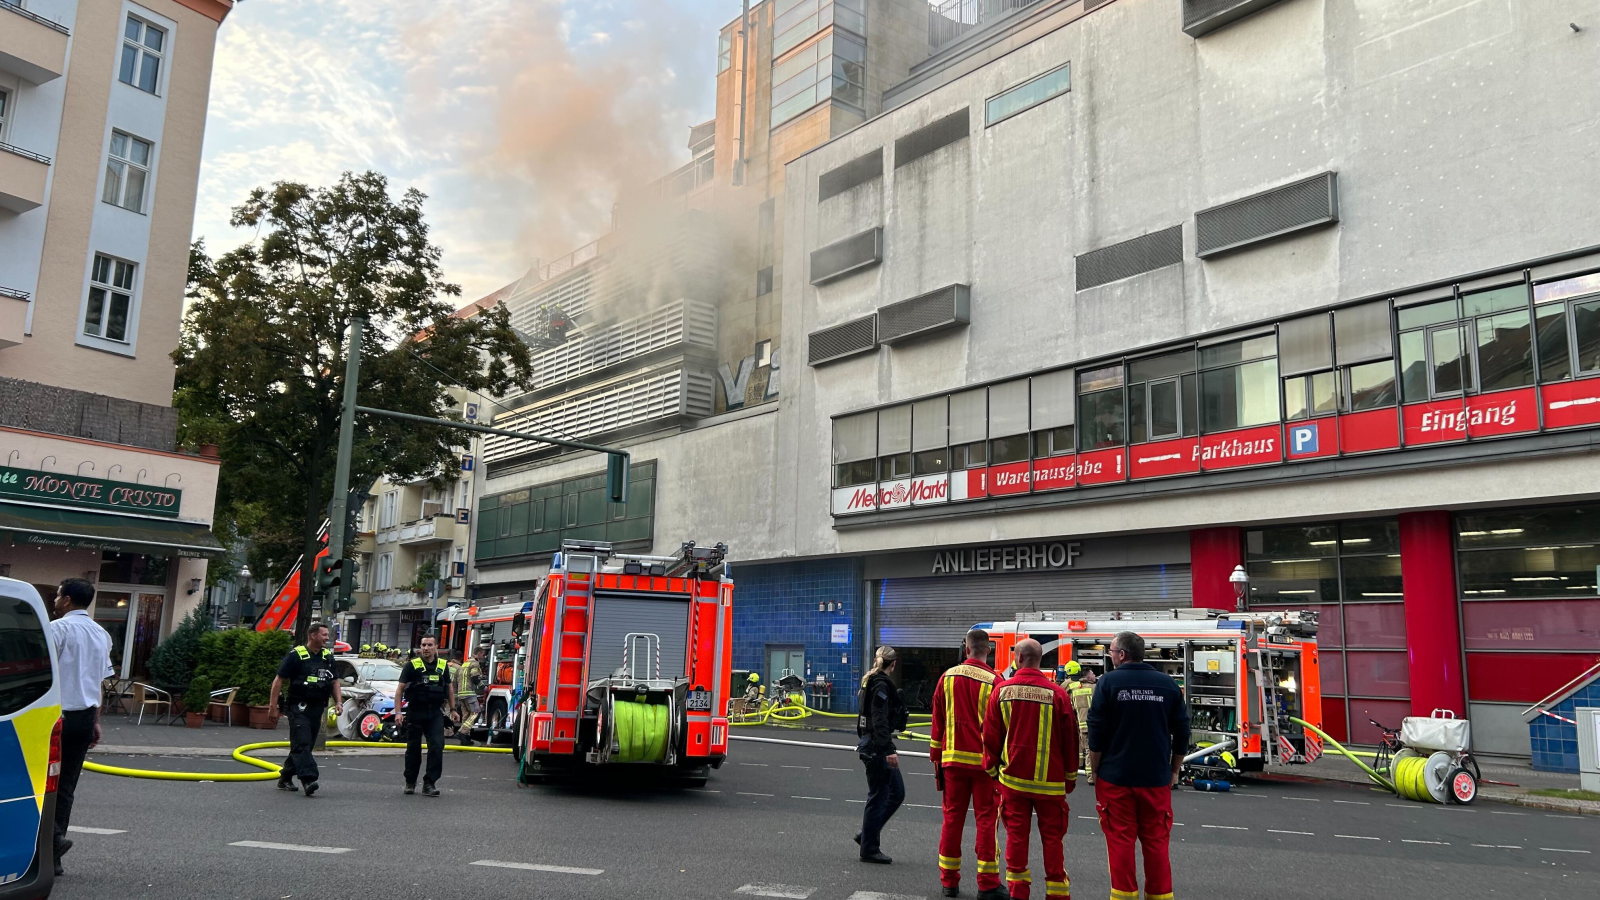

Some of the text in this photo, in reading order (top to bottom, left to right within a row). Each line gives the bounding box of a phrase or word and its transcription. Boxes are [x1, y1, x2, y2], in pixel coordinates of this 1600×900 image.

[1421, 400, 1516, 432] Eingang
[1191, 438, 1275, 462] Parkhaus
[1295, 429, 1312, 451] P
[996, 460, 1103, 486] Warenausgabe
[23, 475, 103, 500] MONTE
[109, 487, 176, 507] CRISTO
[931, 542, 1081, 573] ANLIEFERHOF
